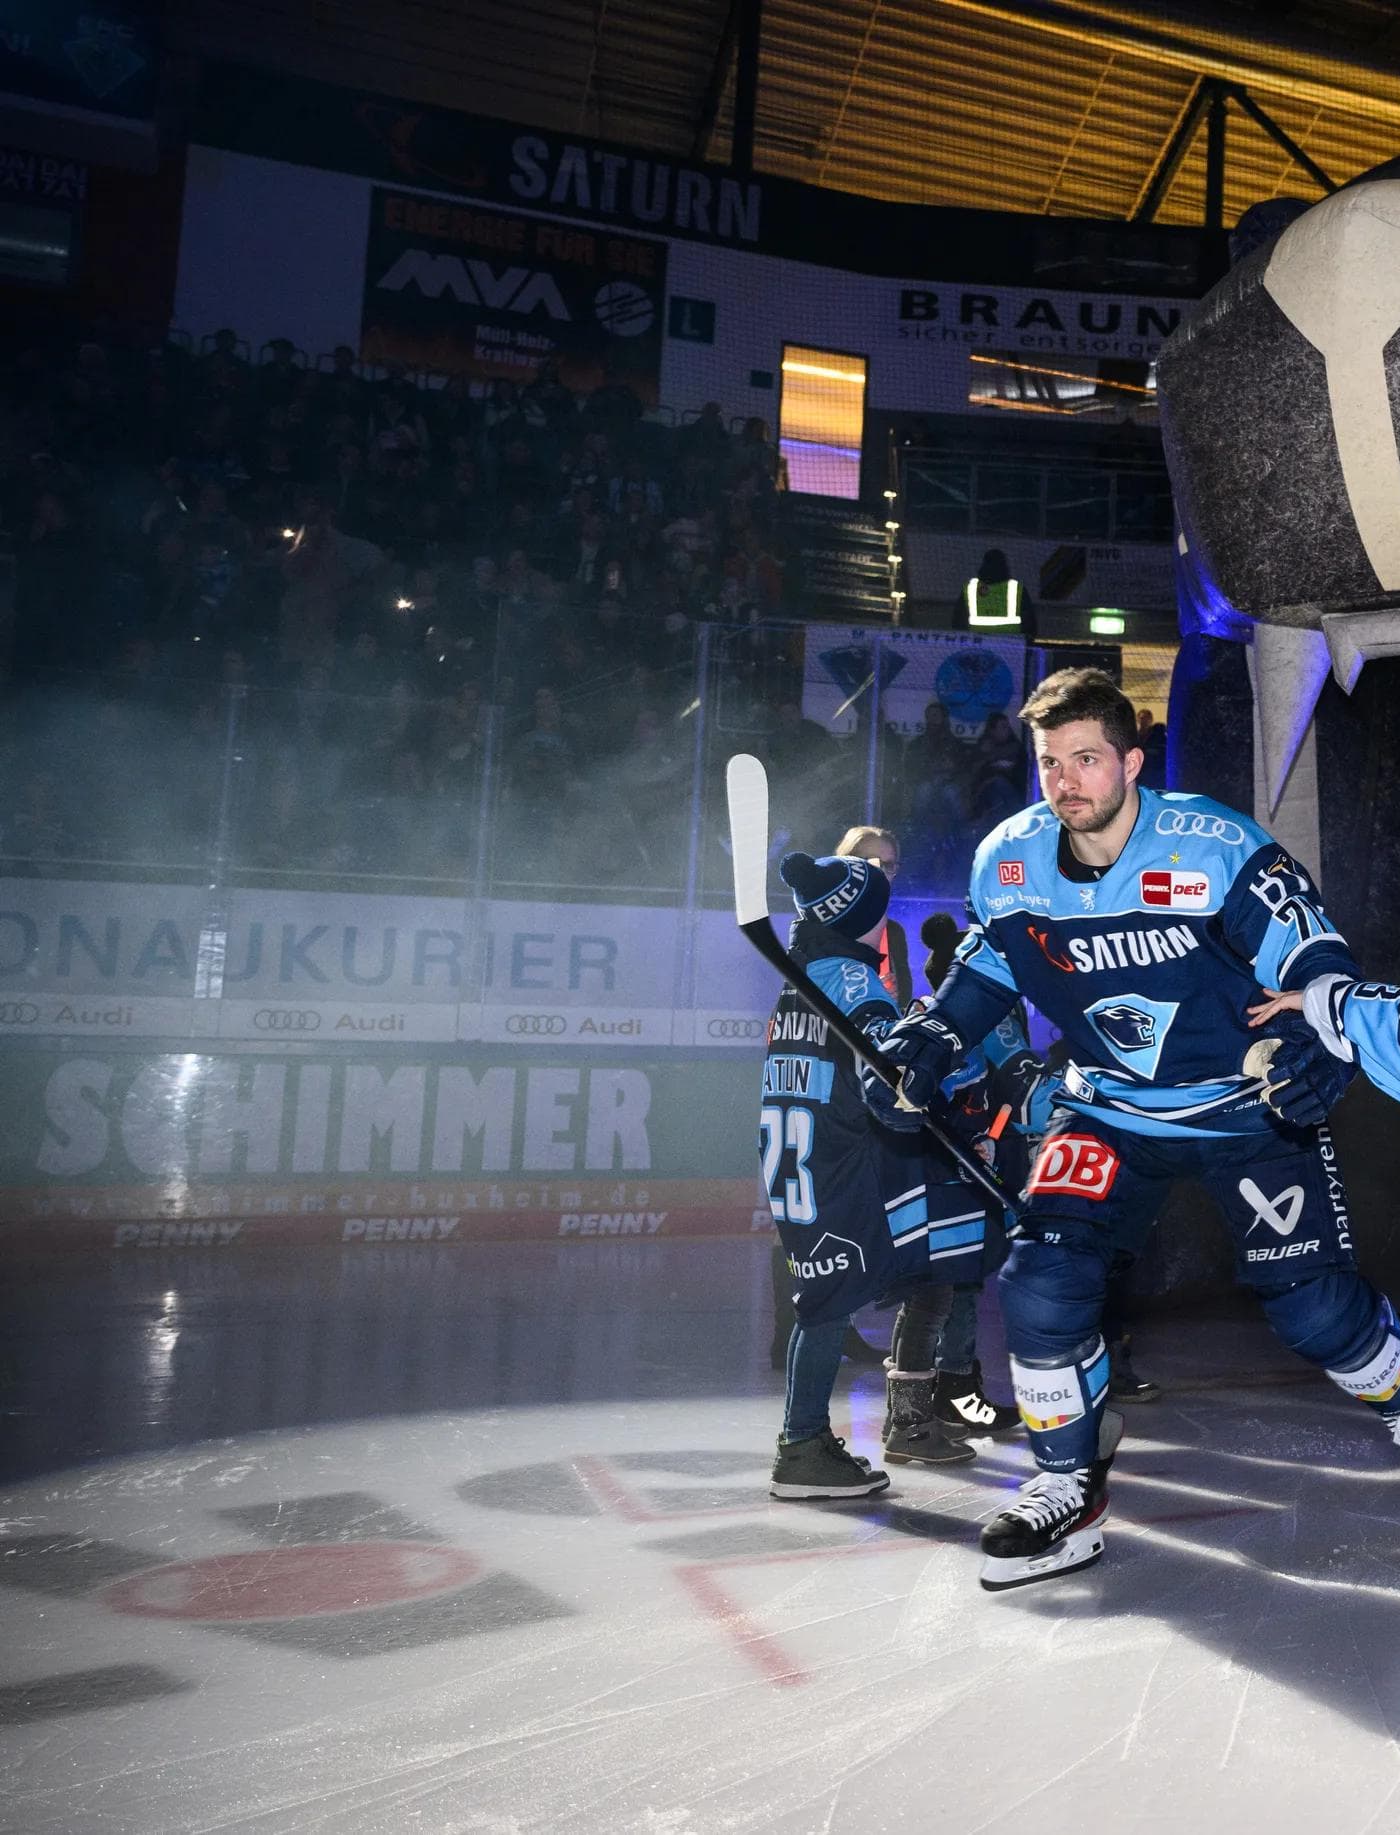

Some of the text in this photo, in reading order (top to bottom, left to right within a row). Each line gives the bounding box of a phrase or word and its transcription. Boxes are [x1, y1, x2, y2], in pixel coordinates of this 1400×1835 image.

[509, 136, 763, 242] SATURN
[376, 249, 573, 322] MVA
[898, 325, 995, 343] sicher
[900, 290, 1181, 338] BRAUN
[1000, 864, 1022, 883] DB
[813, 883, 858, 923] ERC
[1069, 924, 1201, 973] SATURN
[53, 1004, 133, 1028] Audi
[335, 1012, 405, 1033] Audi
[578, 1017, 642, 1036] Audi
[36, 1059, 653, 1175] SCHIMMER
[760, 1106, 818, 1226] 23
[1036, 1140, 1111, 1188] DB
[1247, 1240, 1320, 1262] BAUER
[1051, 1512, 1081, 1541] CCM
